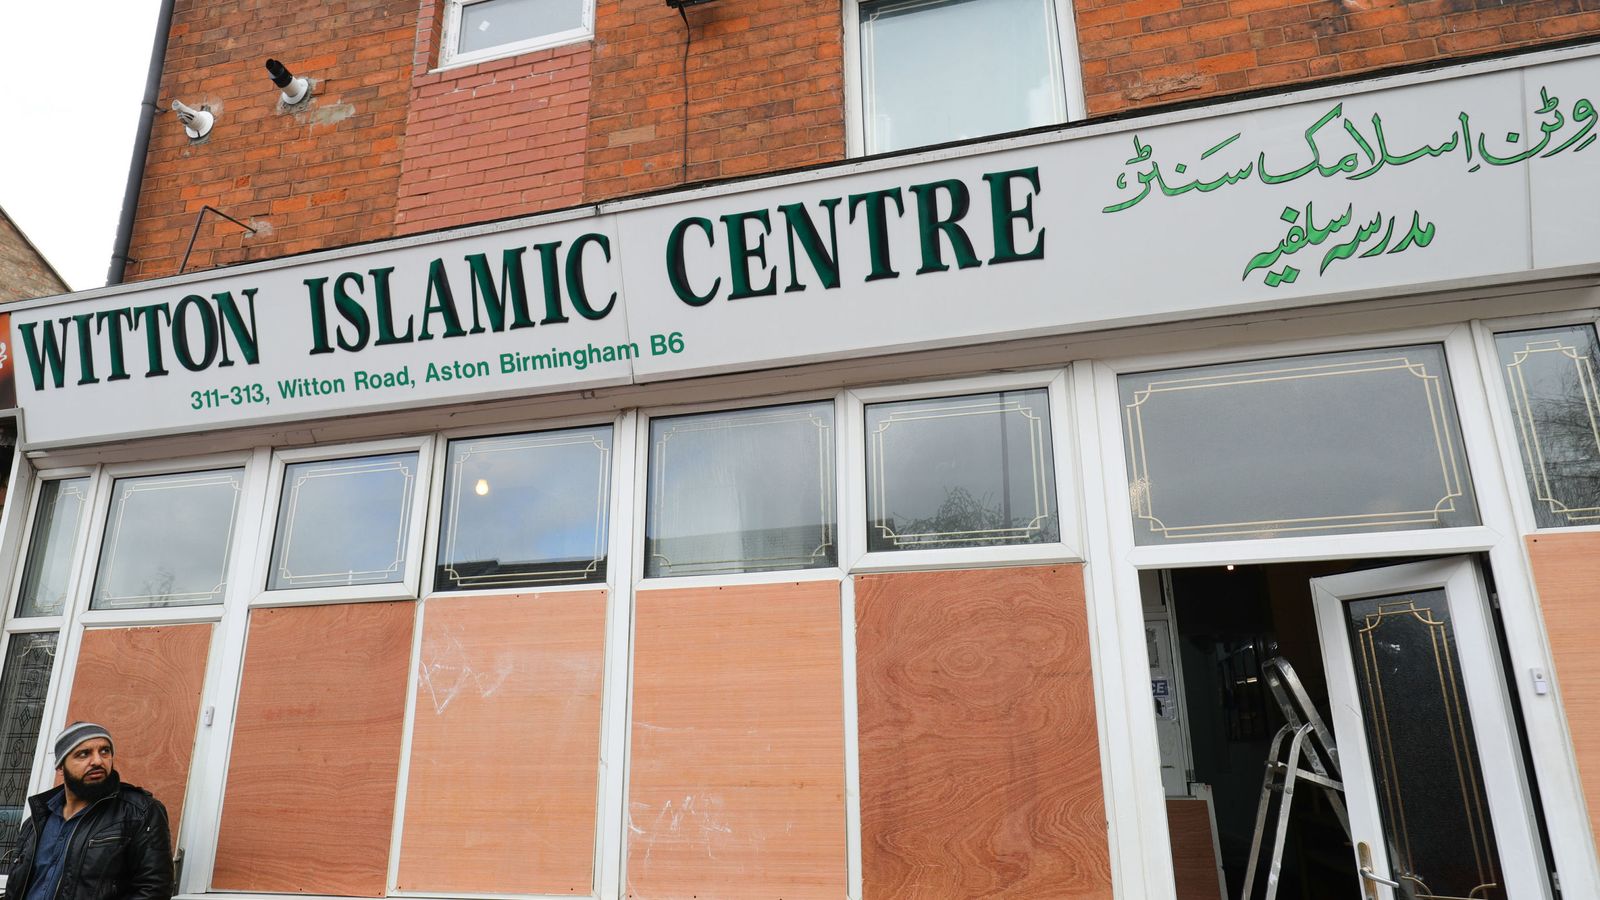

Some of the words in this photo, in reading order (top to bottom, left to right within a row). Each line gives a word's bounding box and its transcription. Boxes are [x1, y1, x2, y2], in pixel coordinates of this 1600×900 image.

[18, 287, 260, 392] WITTON
[303, 232, 618, 357] ISLAMIC
[666, 165, 1047, 308] CENTRE
[191, 382, 270, 411] 311-313,
[278, 378, 346, 399] Witton
[354, 367, 417, 392] Road,
[425, 361, 490, 383] Aston
[499, 343, 640, 374] Birmingham
[650, 331, 686, 356] B6
